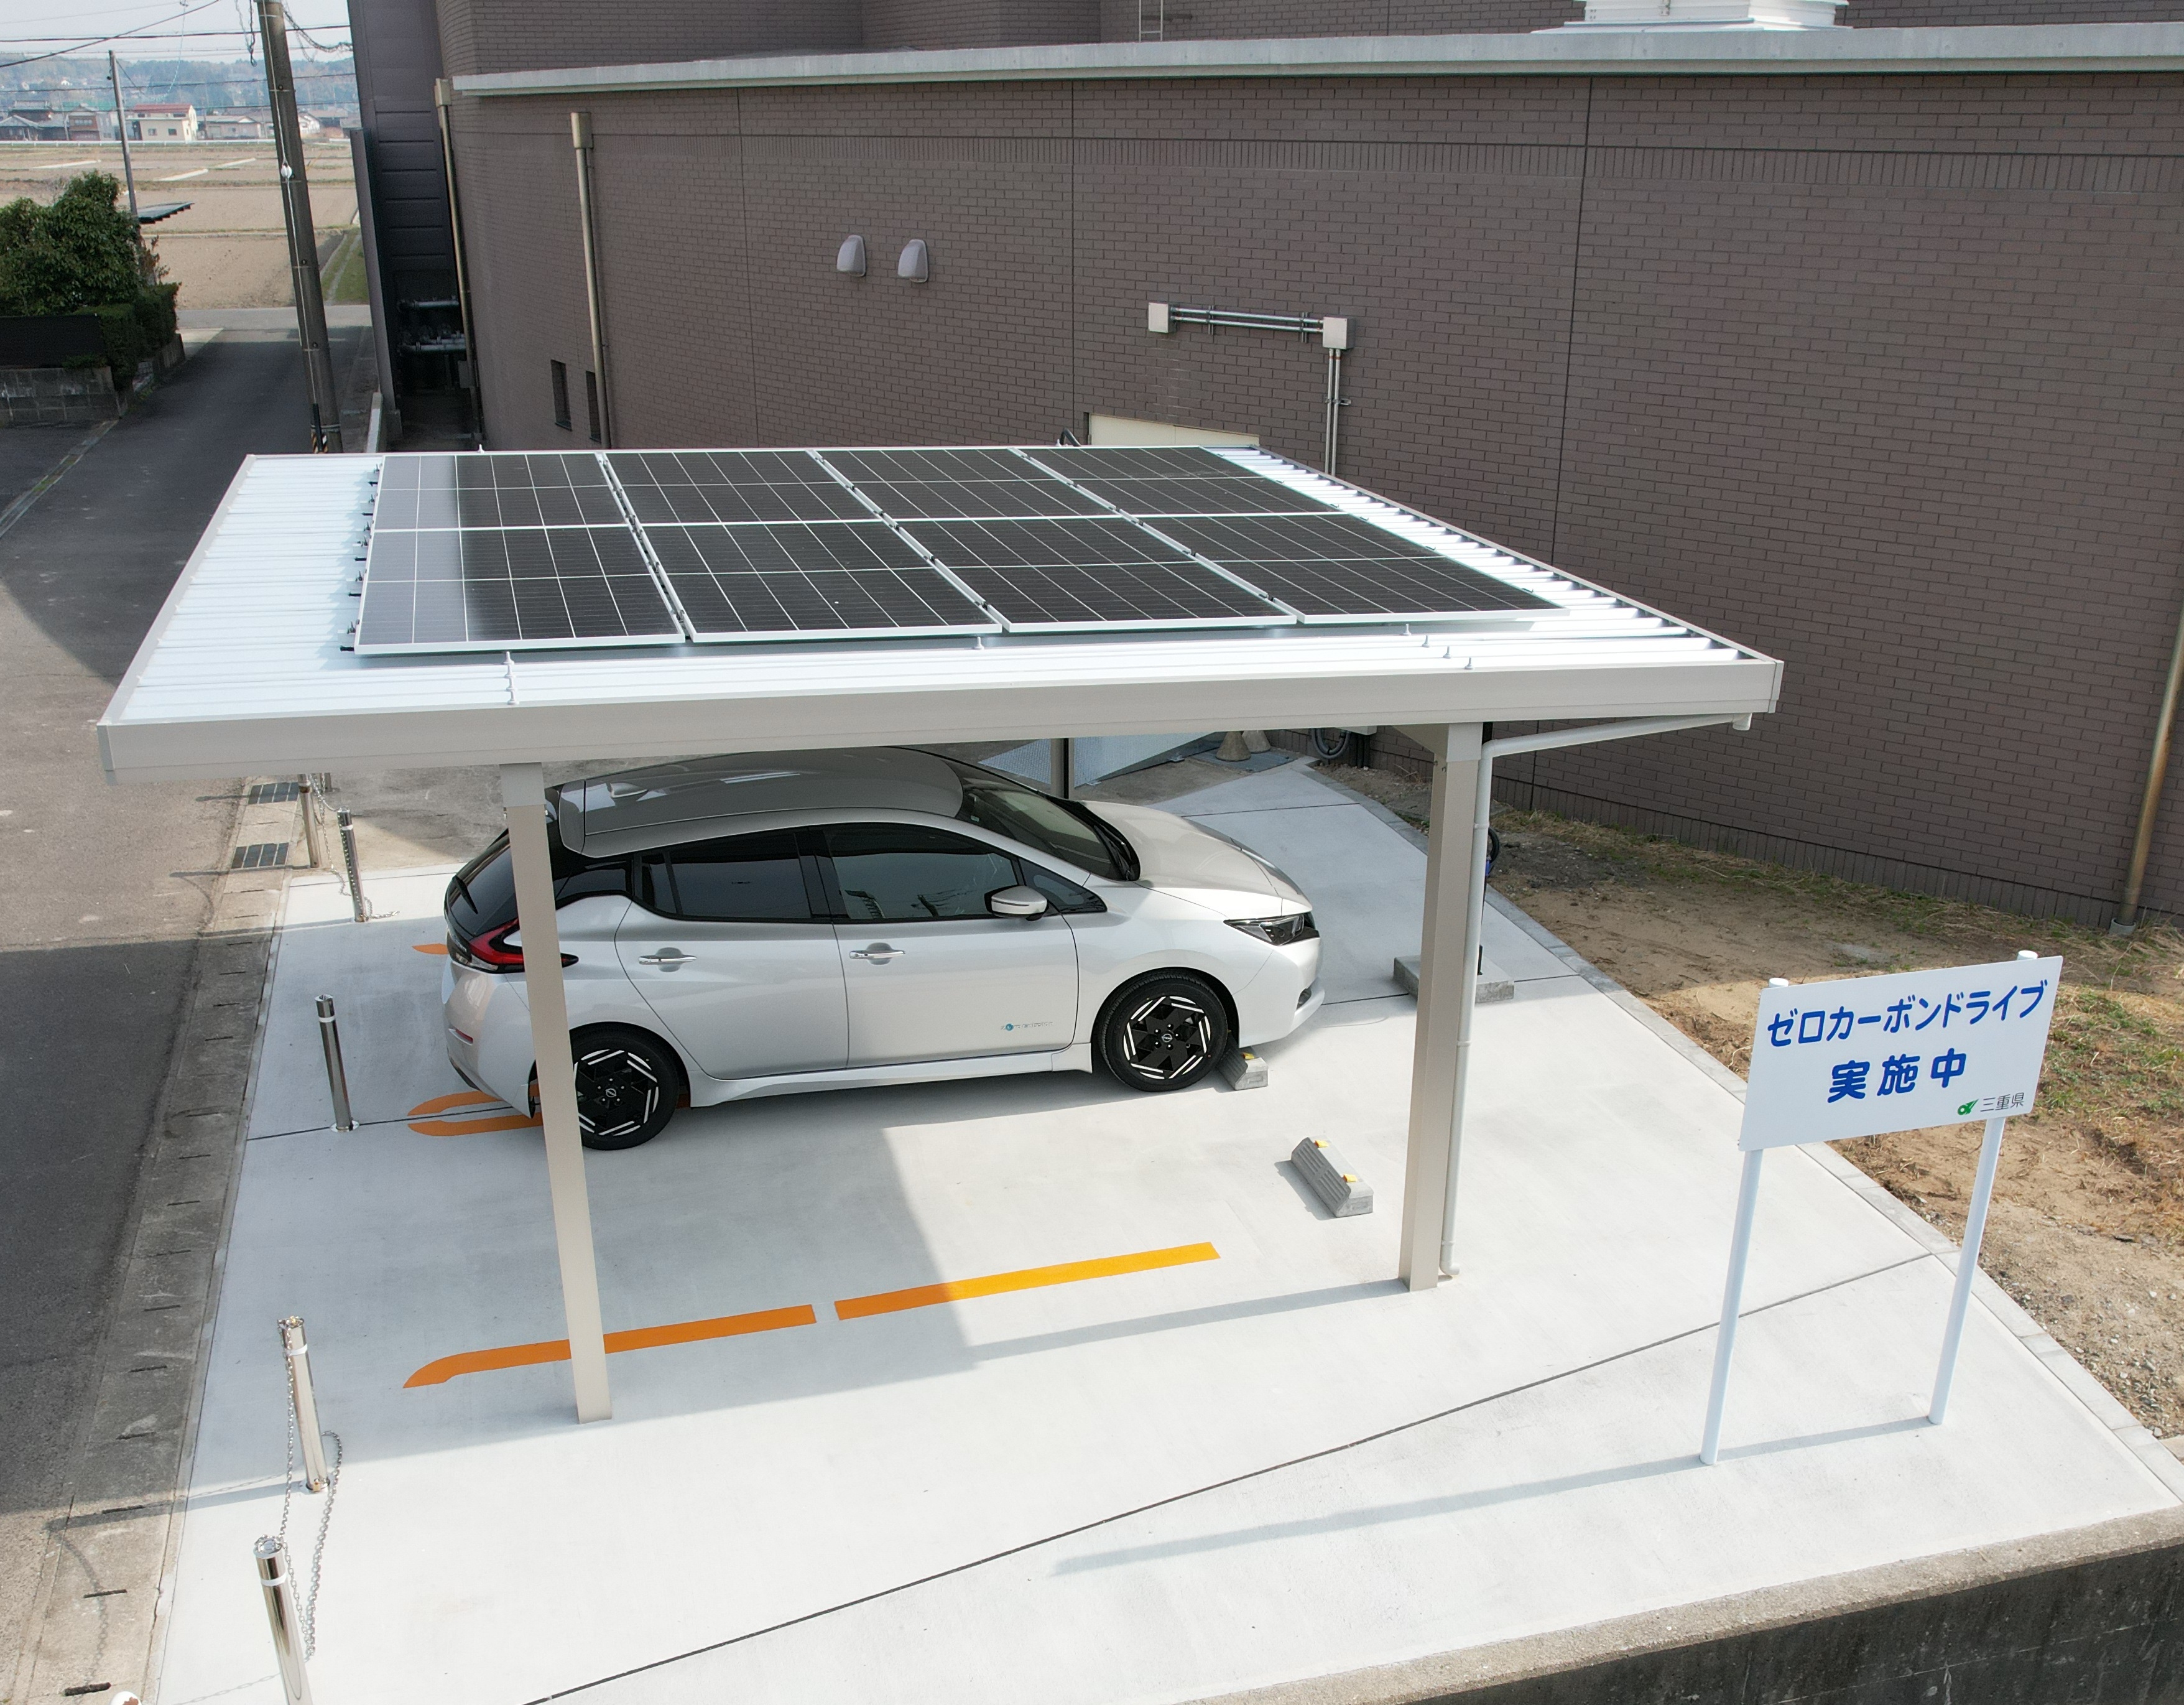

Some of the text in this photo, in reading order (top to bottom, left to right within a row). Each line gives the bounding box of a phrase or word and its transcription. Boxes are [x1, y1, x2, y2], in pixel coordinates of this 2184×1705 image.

[1767, 979, 2048, 1047] ゼロカーボンドライブ
[1827, 1048, 1967, 1103] 実施中
[1980, 1092, 2025, 1112] 三重県
